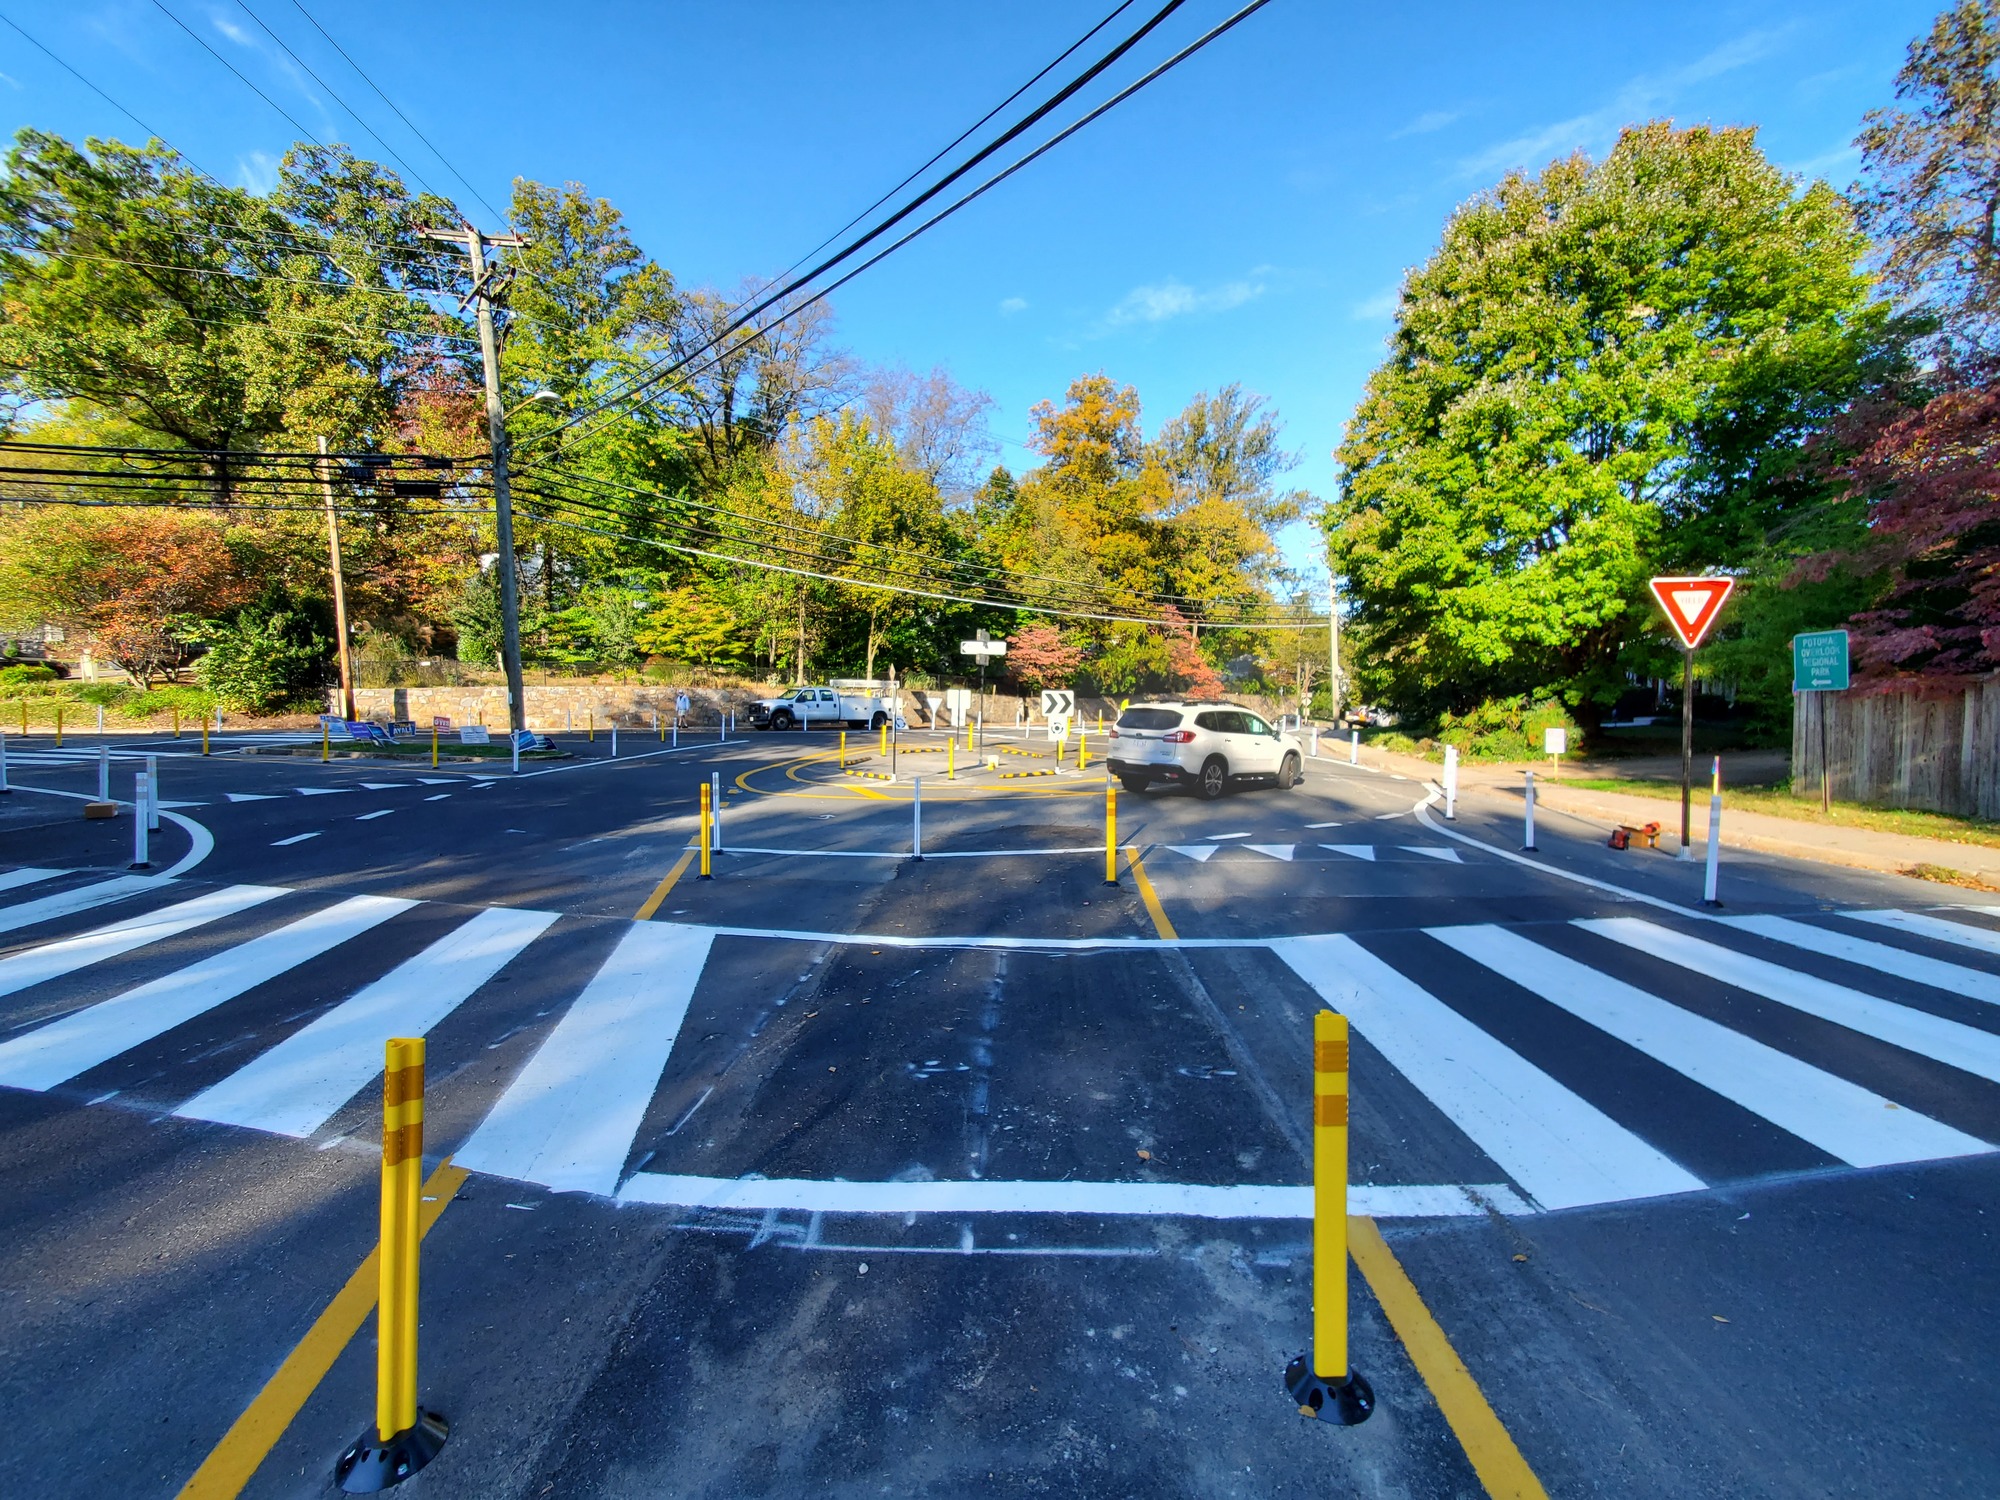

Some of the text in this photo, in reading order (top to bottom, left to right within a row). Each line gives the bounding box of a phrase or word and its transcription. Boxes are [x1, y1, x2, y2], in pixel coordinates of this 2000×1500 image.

[1802, 636, 1838, 647] POTOMA
[1802, 656, 1839, 667] REGIONAL
[1811, 667, 1830, 676] PARK
